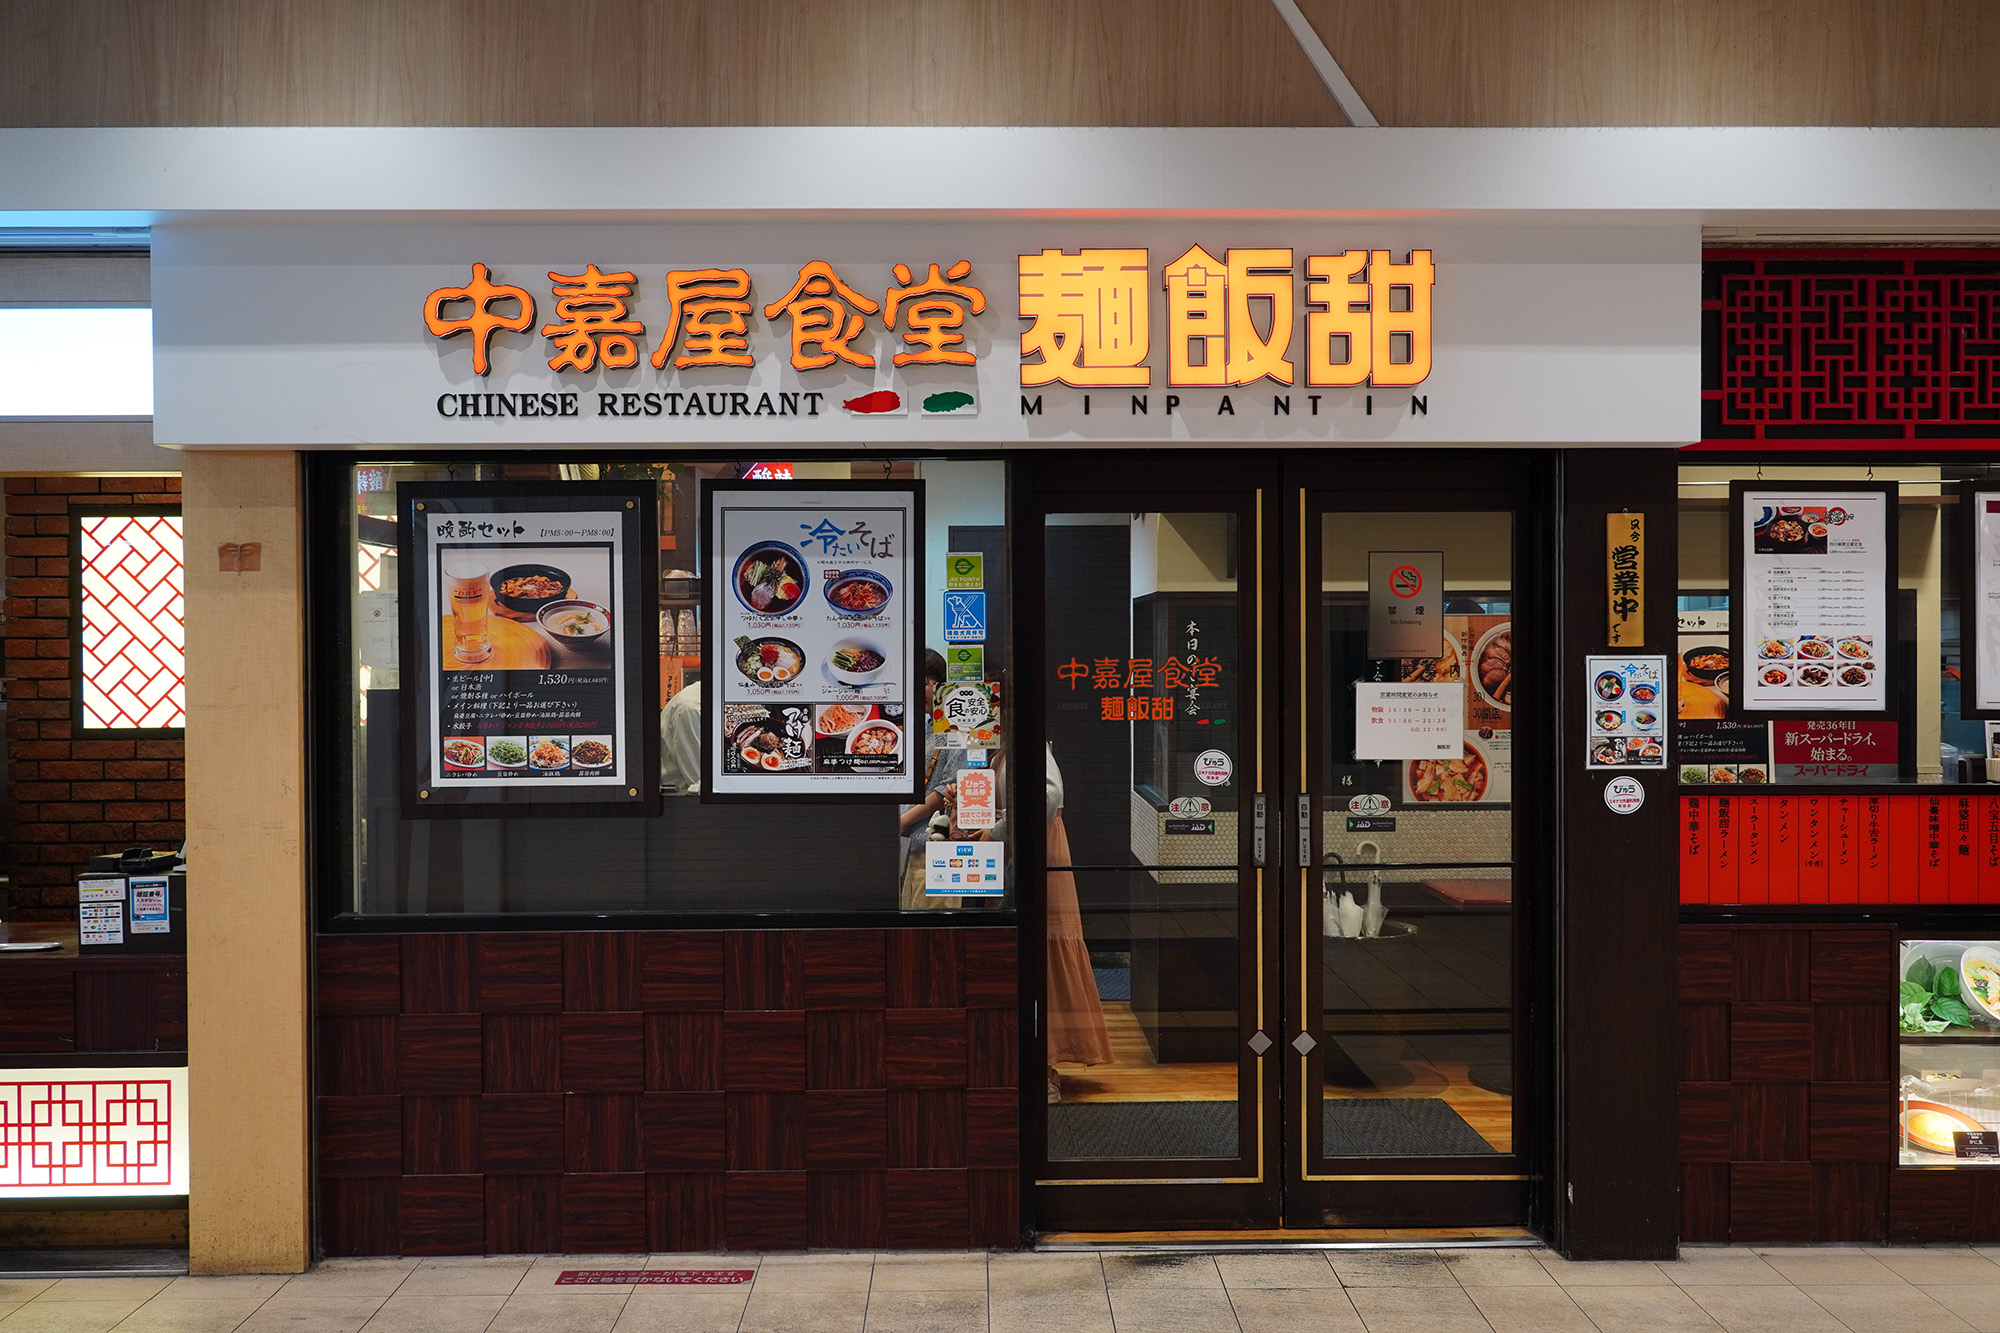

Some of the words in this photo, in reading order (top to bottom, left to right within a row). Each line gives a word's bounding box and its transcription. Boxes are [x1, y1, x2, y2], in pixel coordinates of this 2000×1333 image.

[423, 259, 986, 375] 中嘉屋食堂
[1018, 243, 1436, 388] 麺飯甜
[436, 392, 579, 417] CHINESE
[598, 392, 824, 416] RESTAURANT
[436, 520, 525, 539] 晩酌セット
[1612, 545, 1640, 622] 営業中
[1387, 606, 1425, 616] 禁煙
[1057, 656, 1222, 690] 中嘉屋食堂
[1807, 720, 1857, 731] 発売36年目
[1794, 764, 1869, 777] スーパードライ
[1780, 799, 1789, 843] タンメン
[1809, 799, 1819, 859] ワンタンメン
